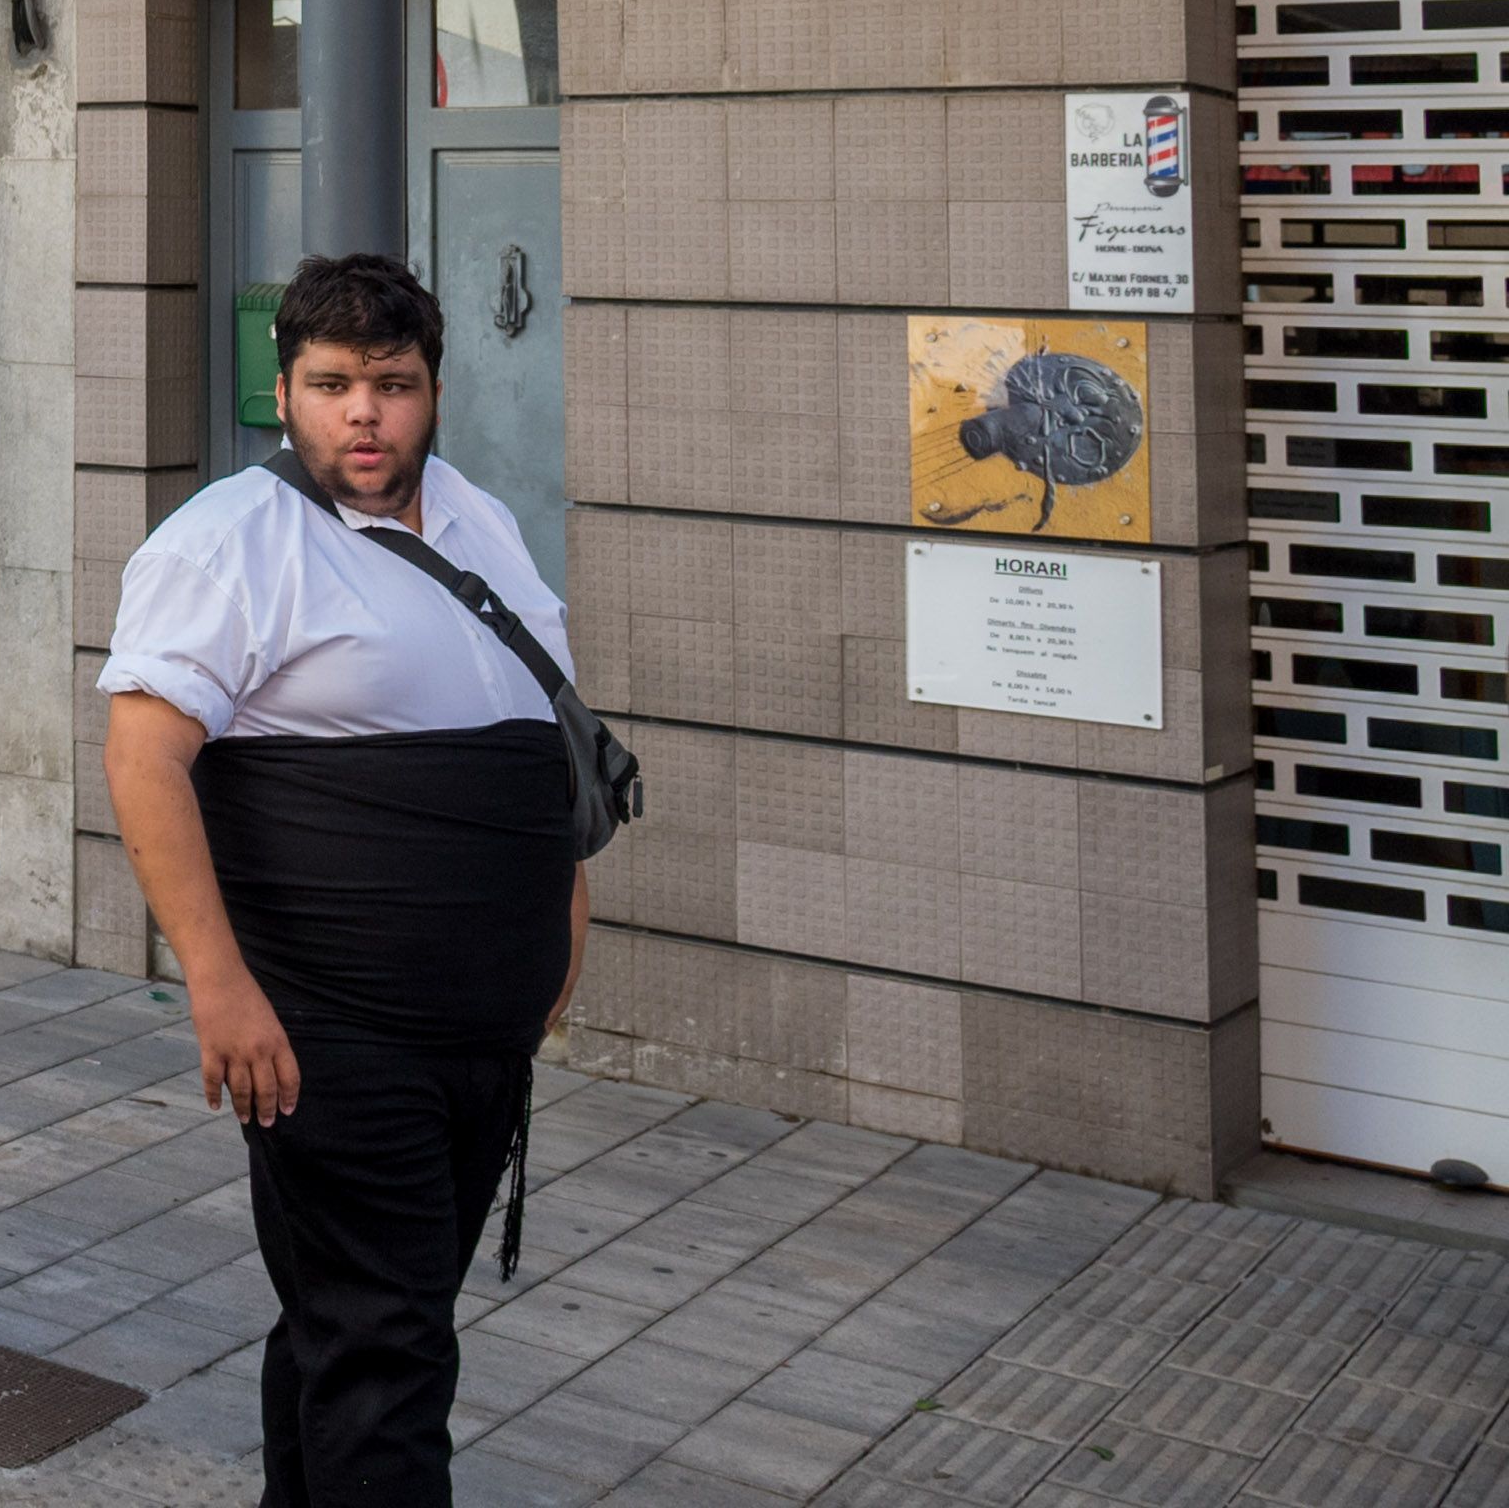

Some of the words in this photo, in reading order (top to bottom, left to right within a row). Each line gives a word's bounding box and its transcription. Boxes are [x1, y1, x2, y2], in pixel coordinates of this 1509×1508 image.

[1123, 132, 1143, 147] LA
[1070, 153, 1143, 167] BARBERIA
[1073, 215, 1186, 242] Figueras
[1175, 274, 1189, 285] 30
[1108, 286, 1121, 297] 93
[1124, 287, 1144, 298] 699
[1146, 287, 1160, 298] 88
[1163, 288, 1178, 298] 47
[995, 558, 1067, 577] HORARI
